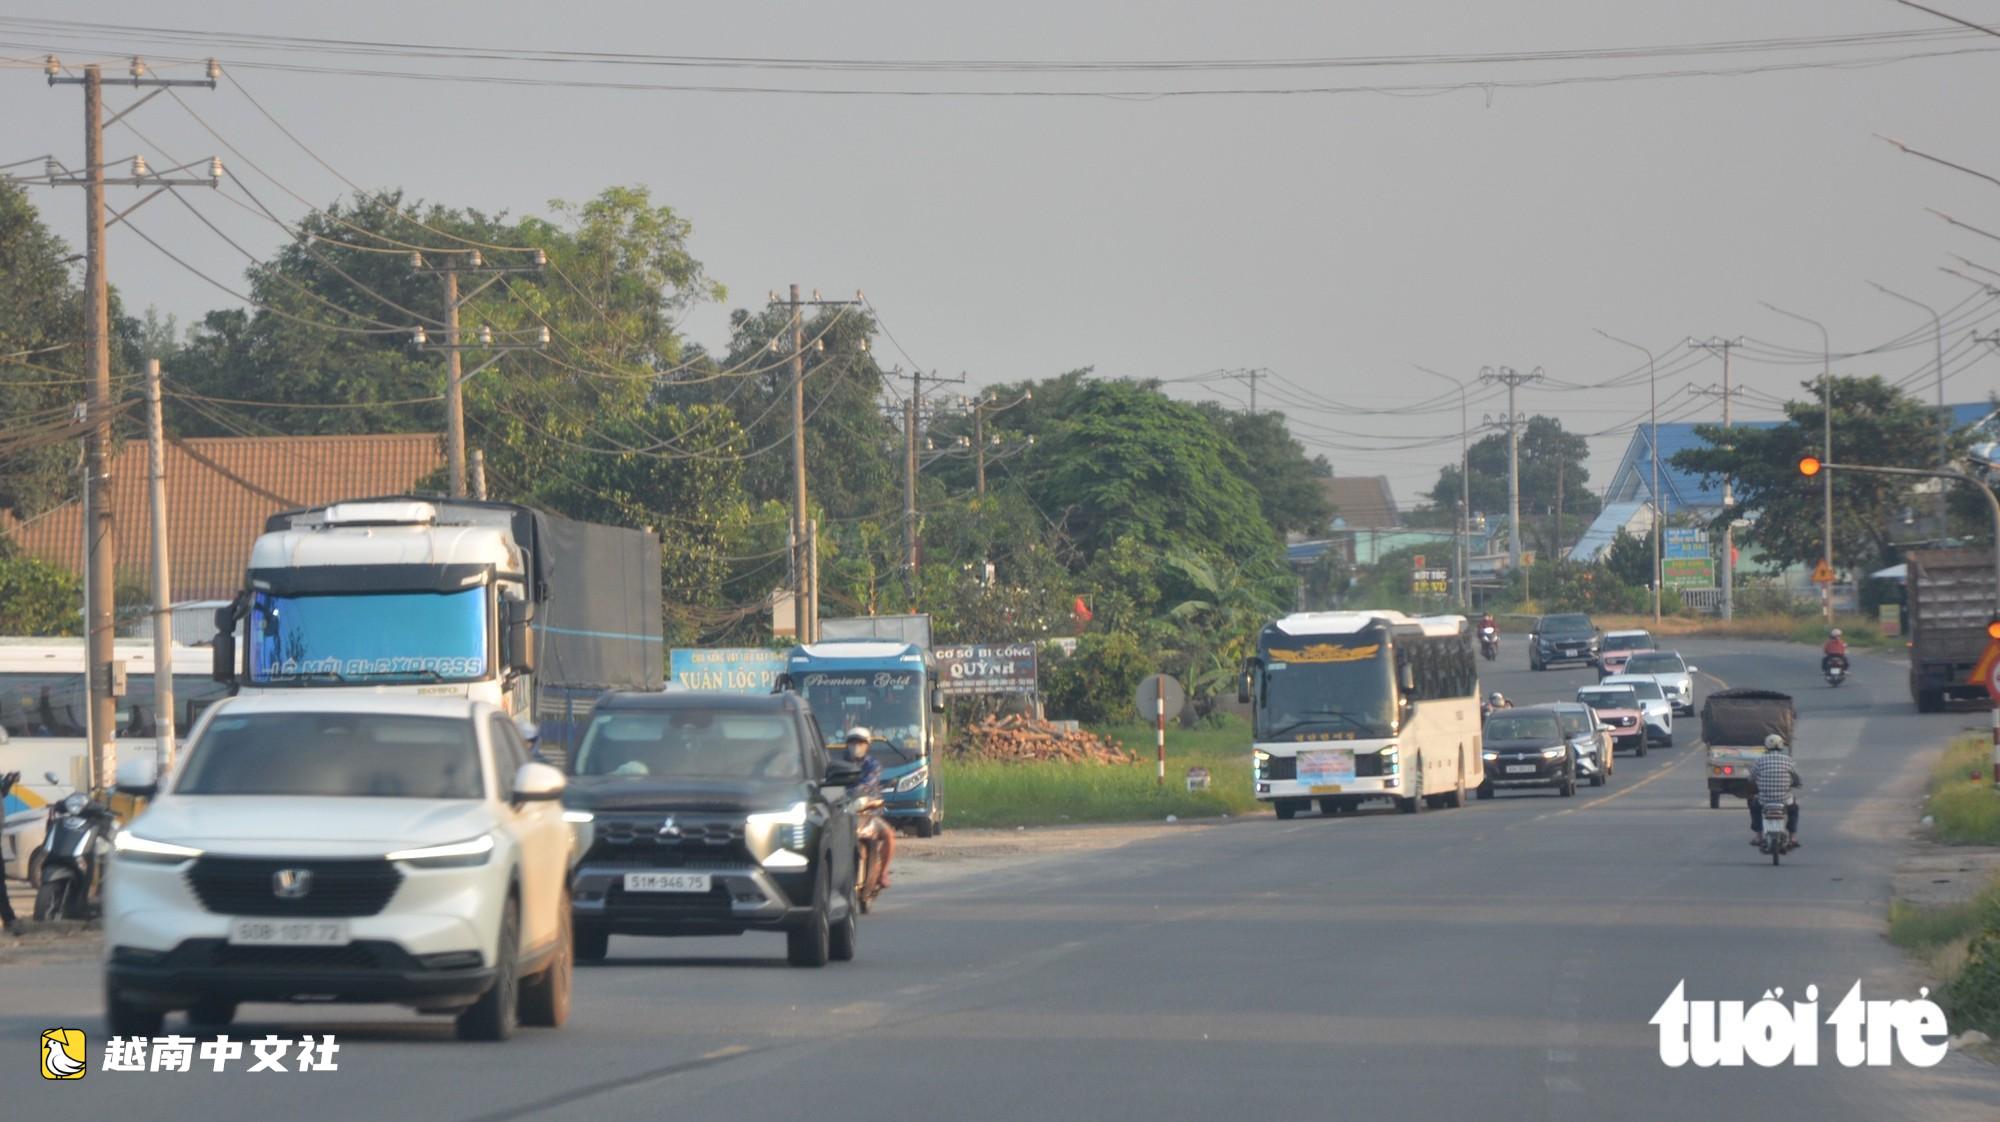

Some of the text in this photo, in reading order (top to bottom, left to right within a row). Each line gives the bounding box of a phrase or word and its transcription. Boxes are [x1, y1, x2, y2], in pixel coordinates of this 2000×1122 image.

[680, 668, 722, 689] XUÂN
[728, 667, 756, 694] LỘC
[804, 672, 913, 688] Premium Gold
